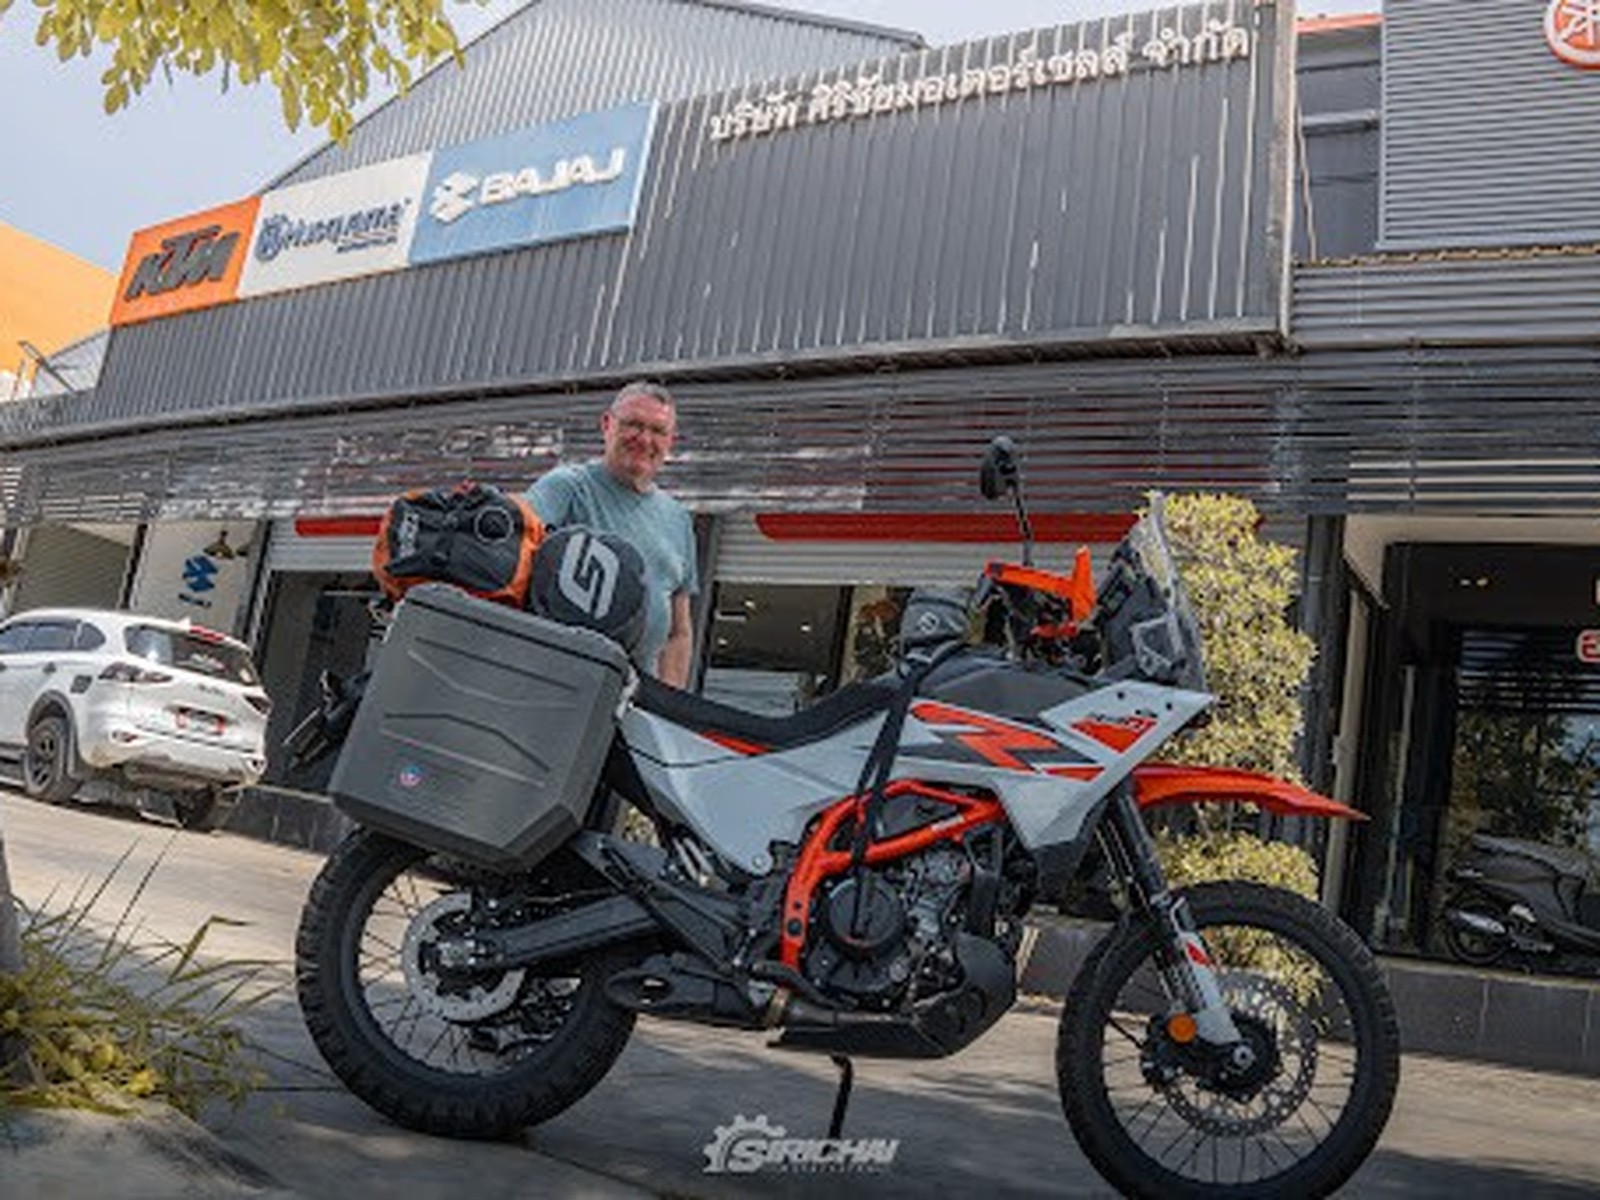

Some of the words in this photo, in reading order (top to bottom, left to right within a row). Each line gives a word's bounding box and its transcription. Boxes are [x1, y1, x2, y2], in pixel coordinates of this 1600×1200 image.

[710, 90, 802, 140] บริษัท
[1142, 19, 1249, 67] จำกัด
[481, 148, 625, 204] BAJAJ
[124, 224, 240, 302] KTM
